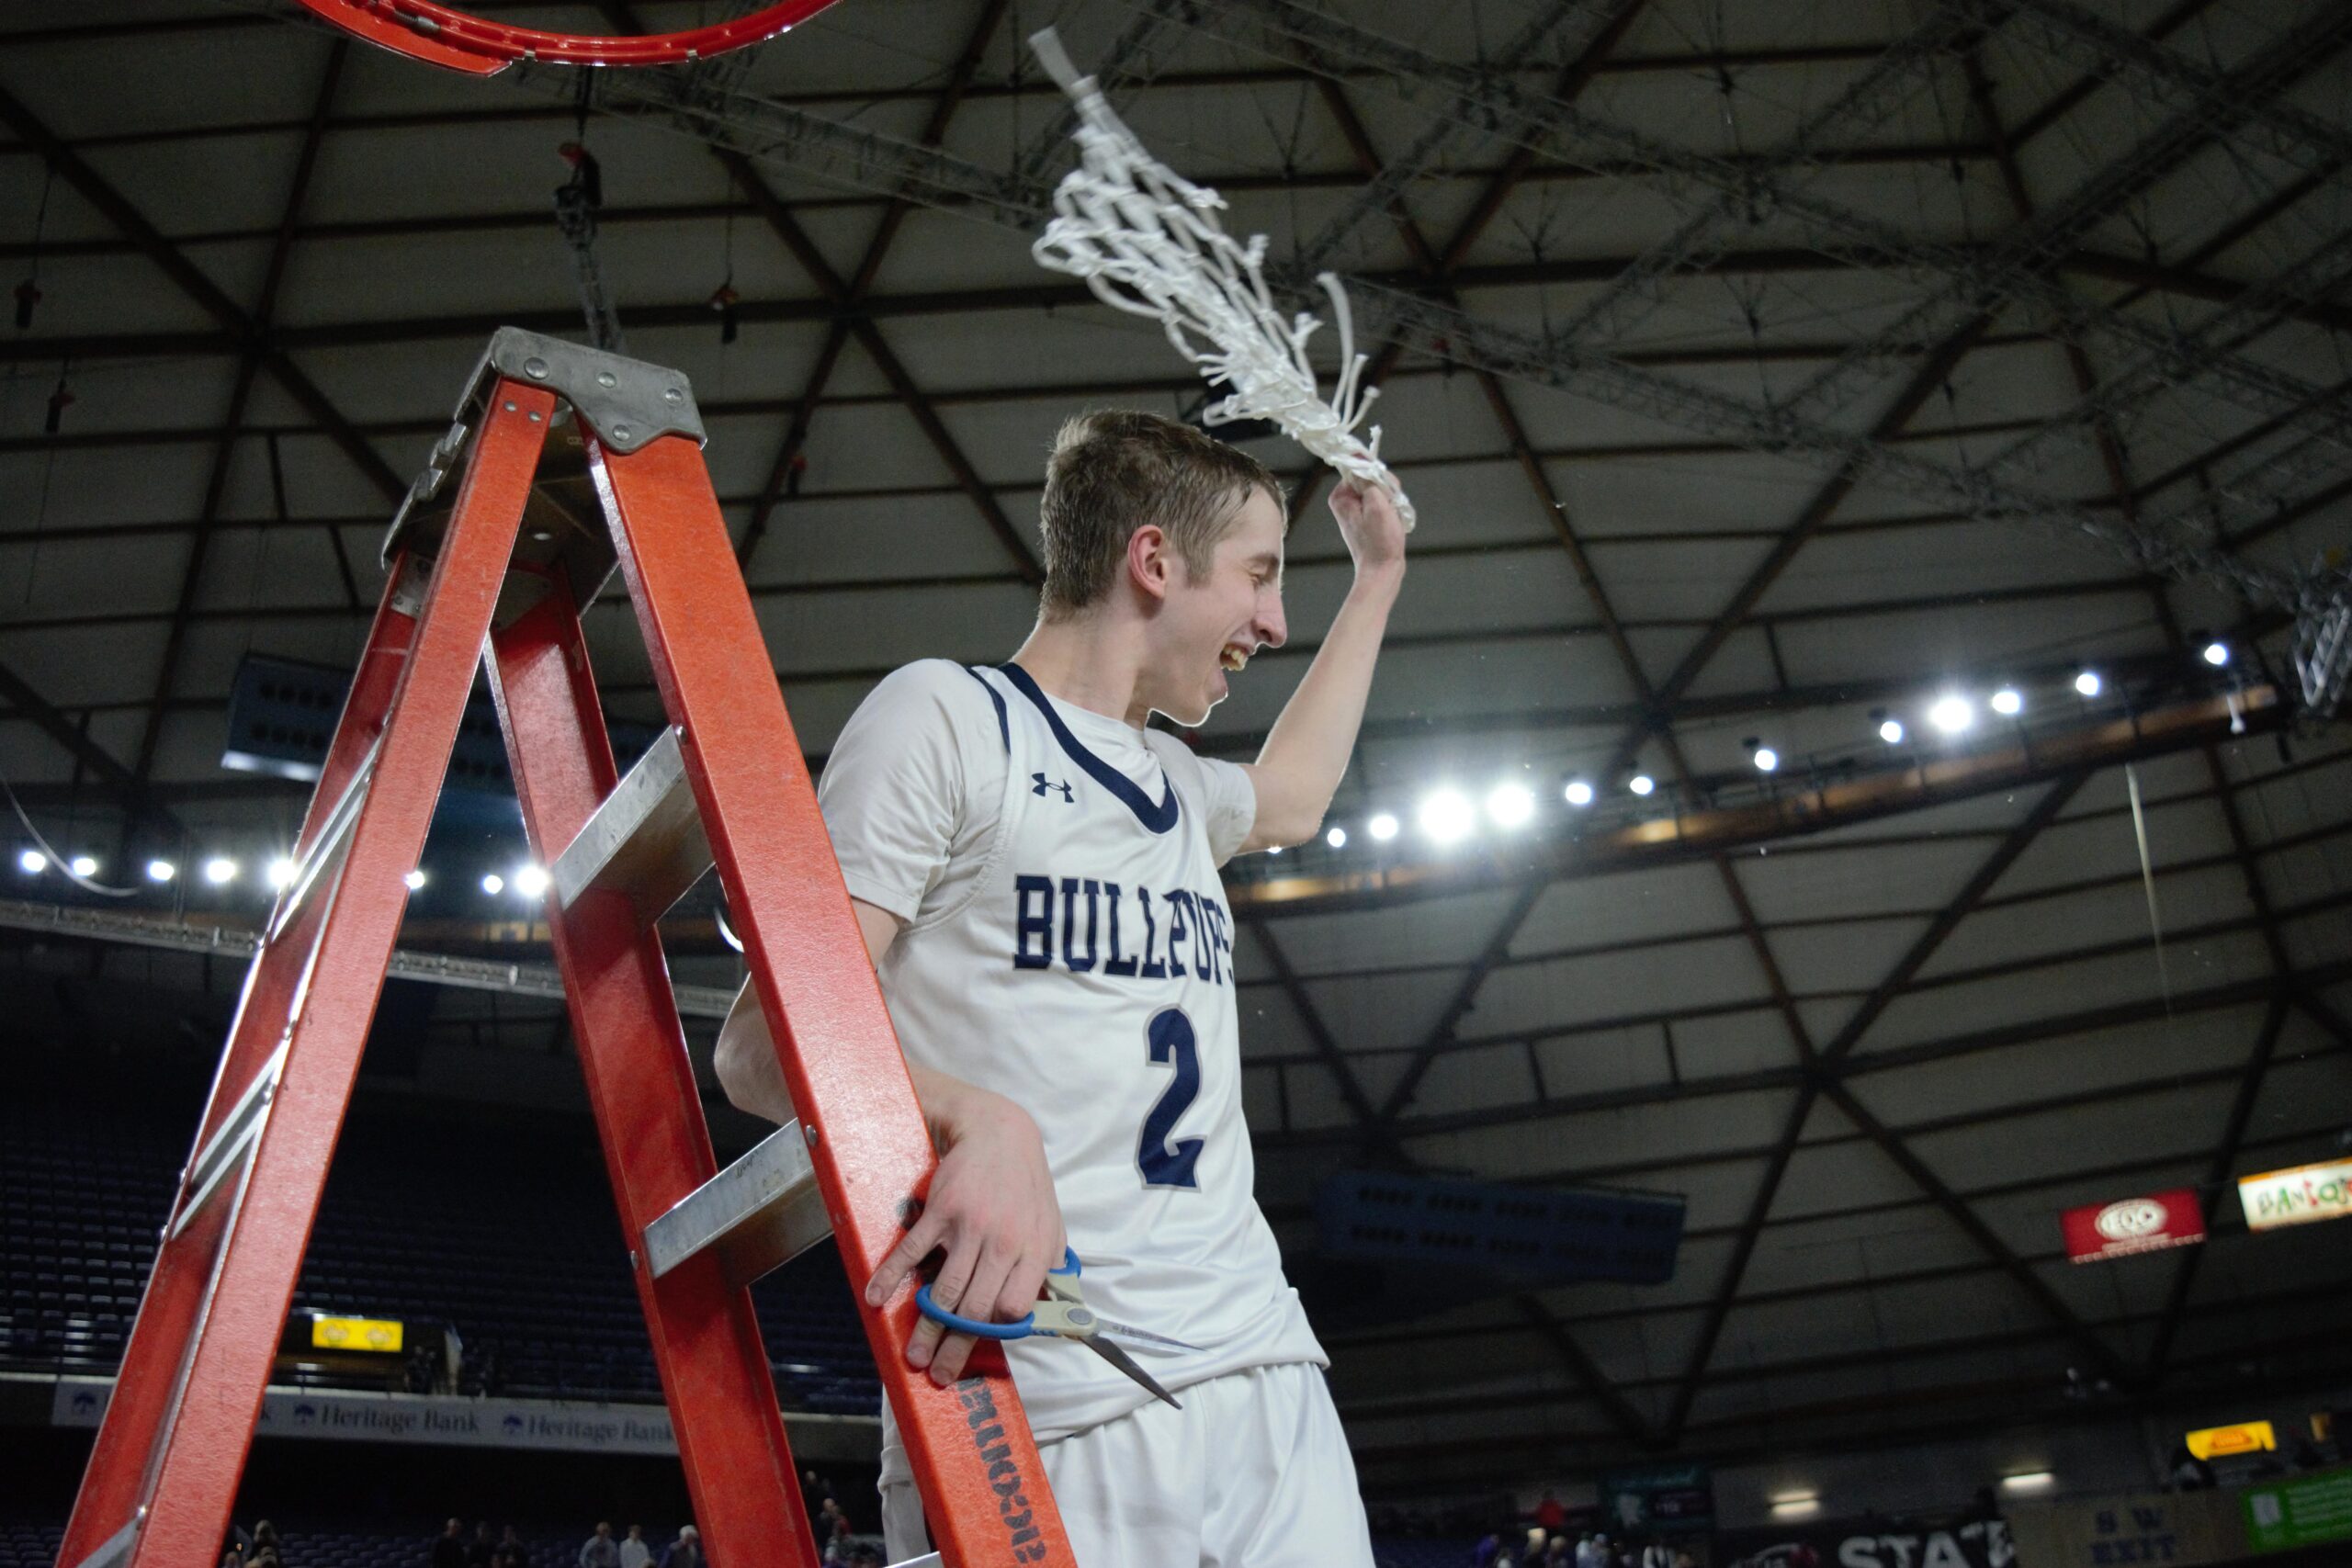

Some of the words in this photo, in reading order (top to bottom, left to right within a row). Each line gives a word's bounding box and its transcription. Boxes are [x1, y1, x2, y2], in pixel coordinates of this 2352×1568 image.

[1135, 1004, 1205, 1191] 2
[322, 1404, 415, 1434] Heritage
[424, 1408, 480, 1433] Bank
[528, 1416, 618, 1442] Heritage
[2090, 1534, 2177, 1563] EXIT
